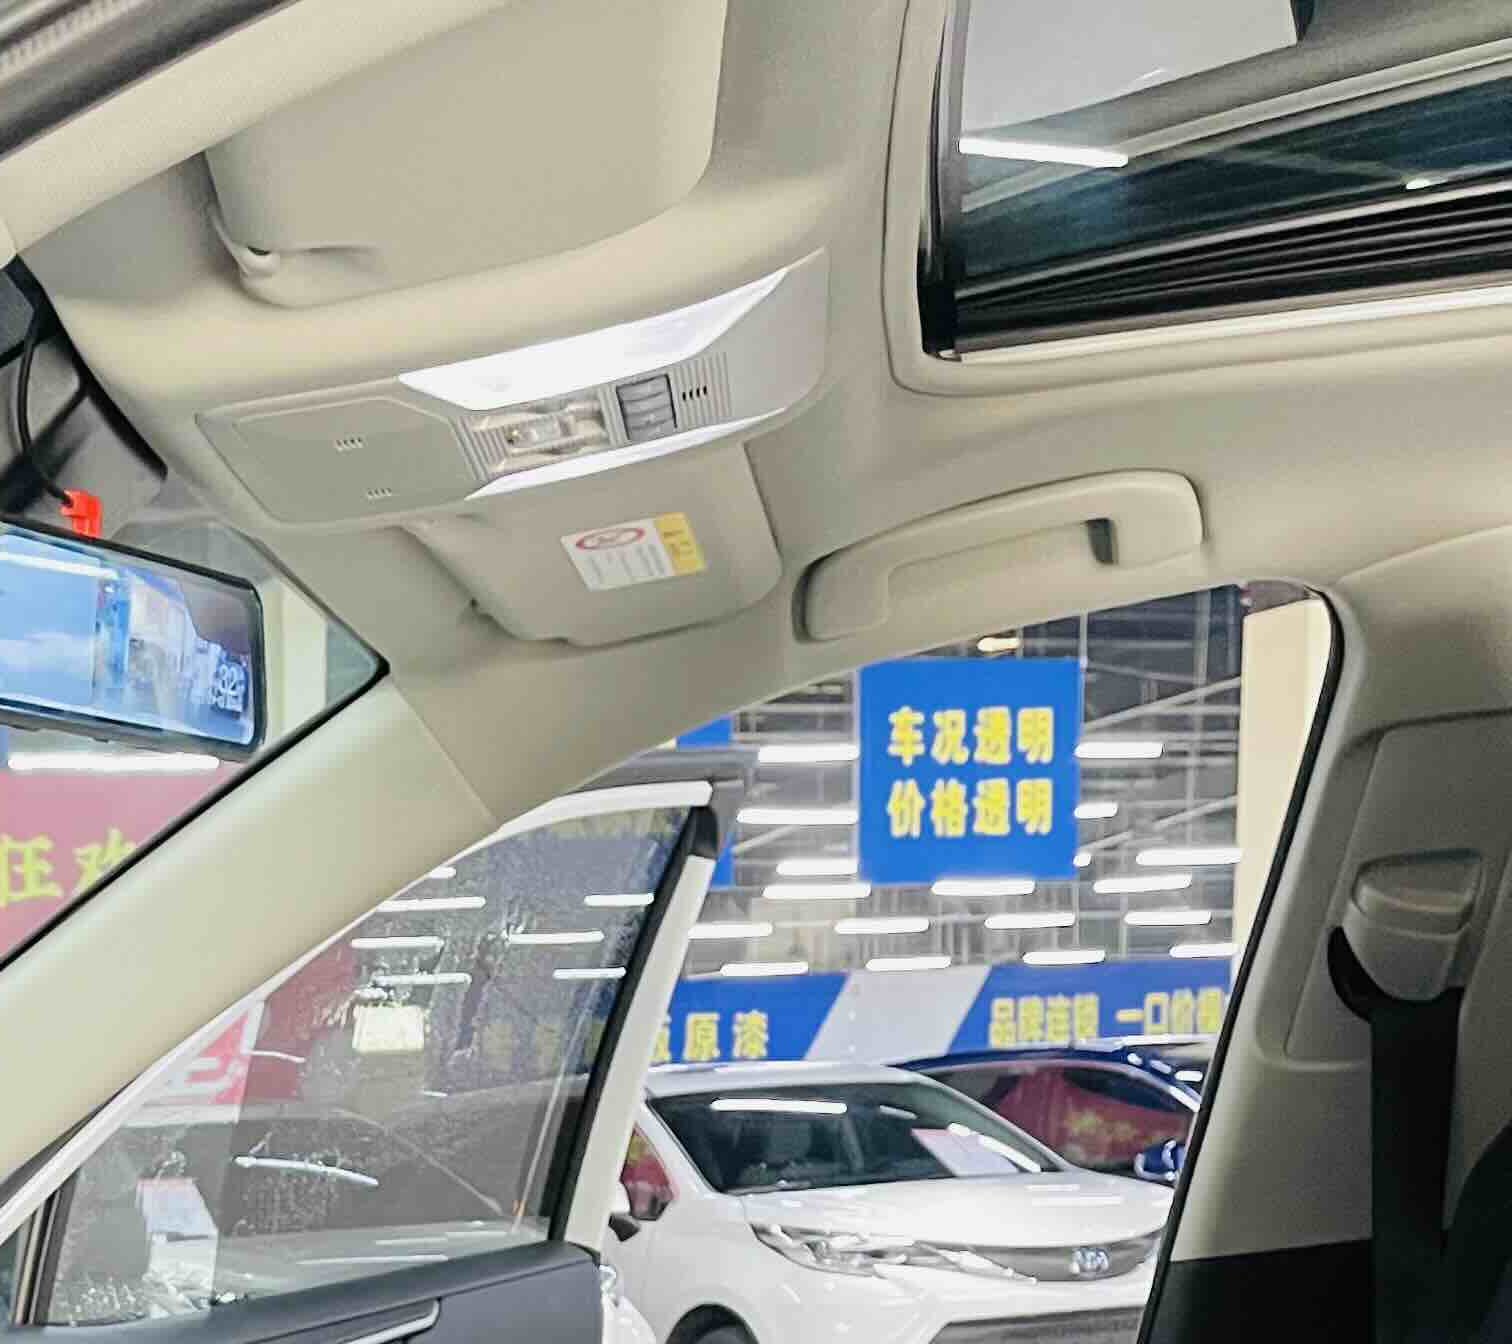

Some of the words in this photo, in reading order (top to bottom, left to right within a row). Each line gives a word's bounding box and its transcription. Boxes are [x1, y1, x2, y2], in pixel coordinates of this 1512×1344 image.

[887, 706, 1055, 766] 车况透明
[886, 778, 1054, 837] 价格透明
